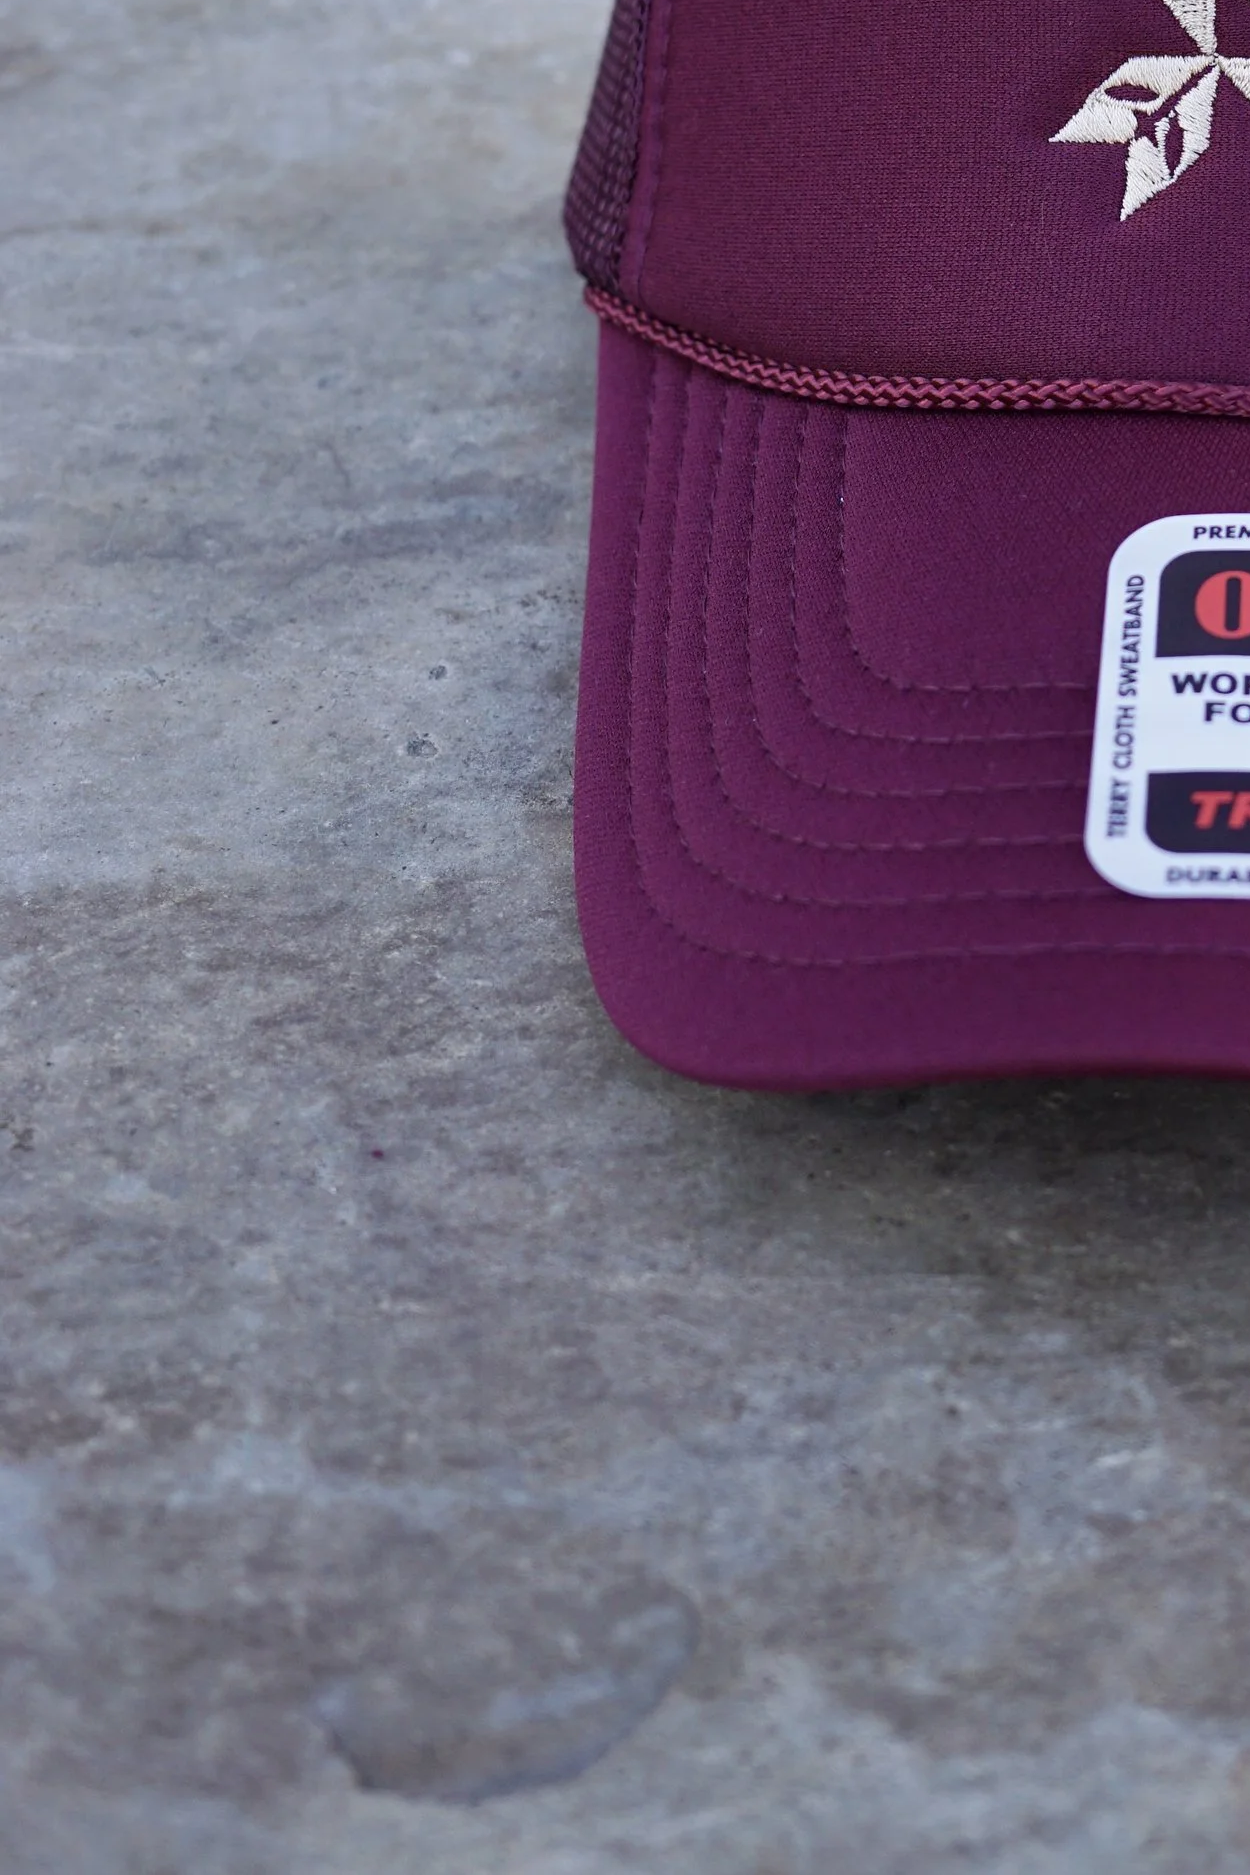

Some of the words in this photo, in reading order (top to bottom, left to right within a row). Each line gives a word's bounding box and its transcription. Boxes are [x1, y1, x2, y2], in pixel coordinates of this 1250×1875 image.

[1118, 574, 1145, 696] SWEATBAND
[1112, 704, 1136, 770] CLOTH
[1107, 775, 1130, 837] TERRY
